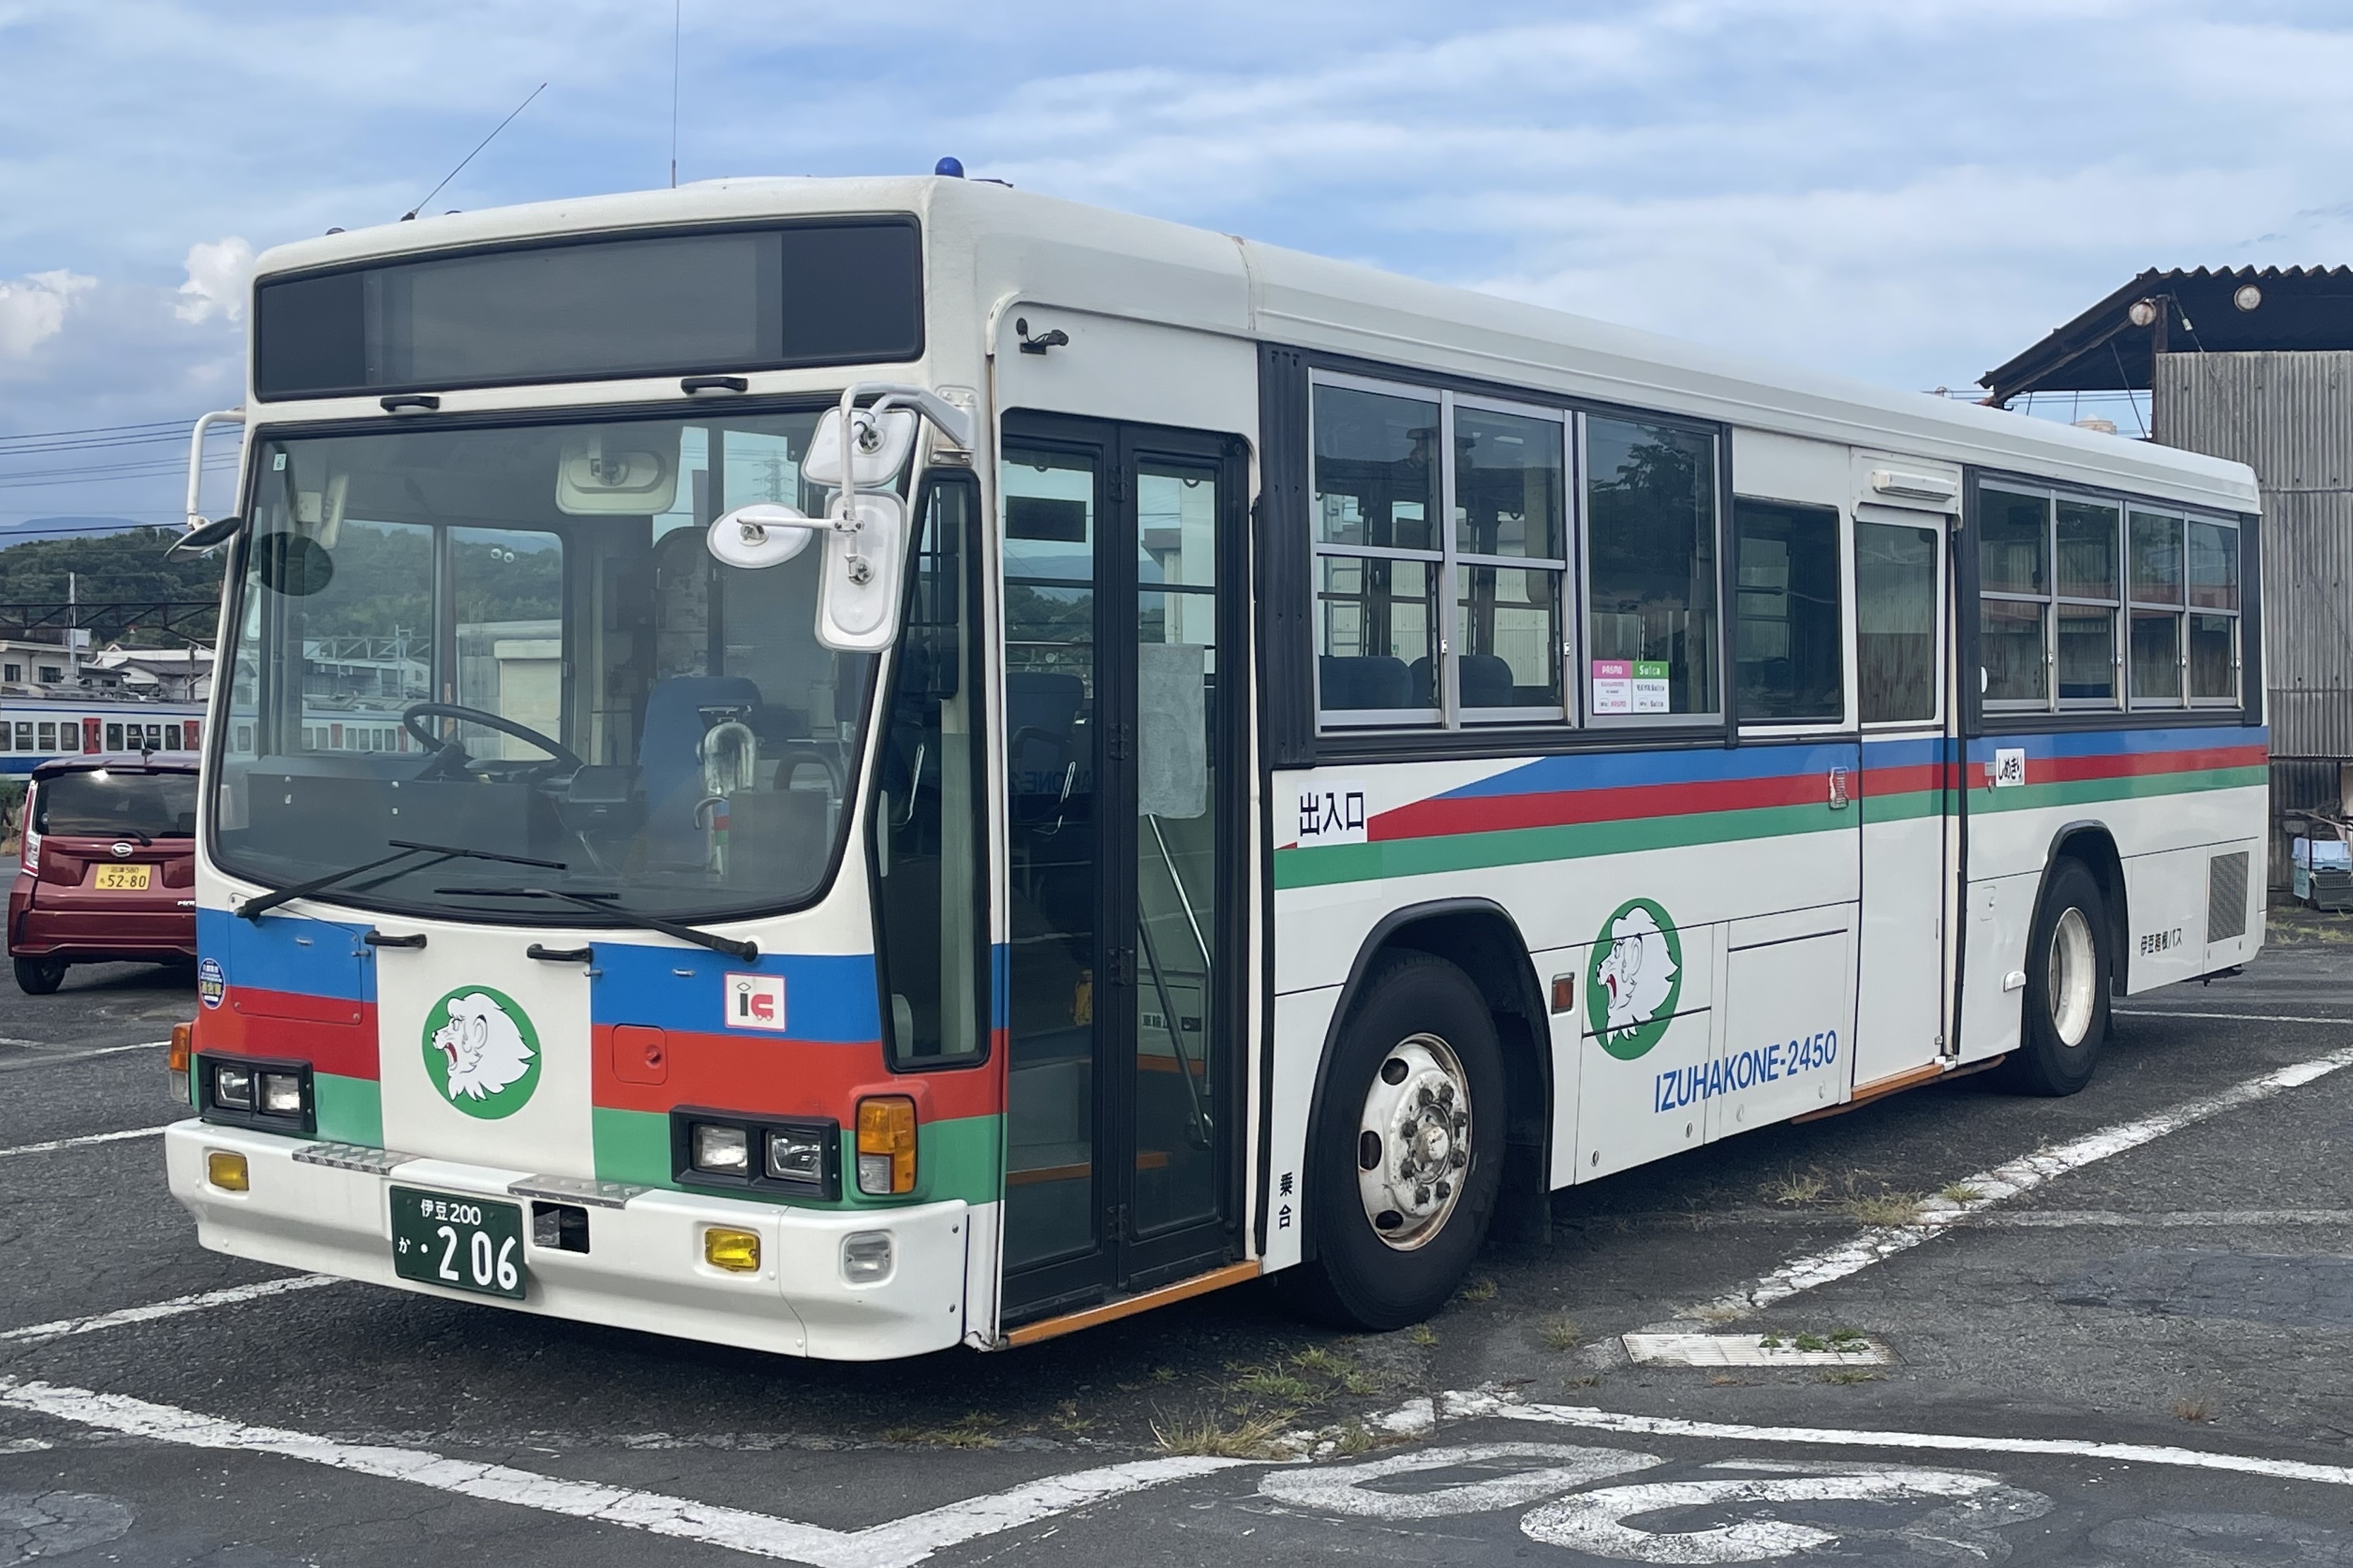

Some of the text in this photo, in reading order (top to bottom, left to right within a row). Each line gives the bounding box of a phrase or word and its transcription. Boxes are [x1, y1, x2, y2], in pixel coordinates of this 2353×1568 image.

[1998, 756, 2023, 781] しめきり
[1299, 791, 1364, 837] 出入口
[107, 874, 147, 887] 52-80
[1654, 1029, 1837, 1113] IZUHAKONE-2450
[420, 1198, 482, 1226] 伊豆200
[398, 1236, 411, 1254] か
